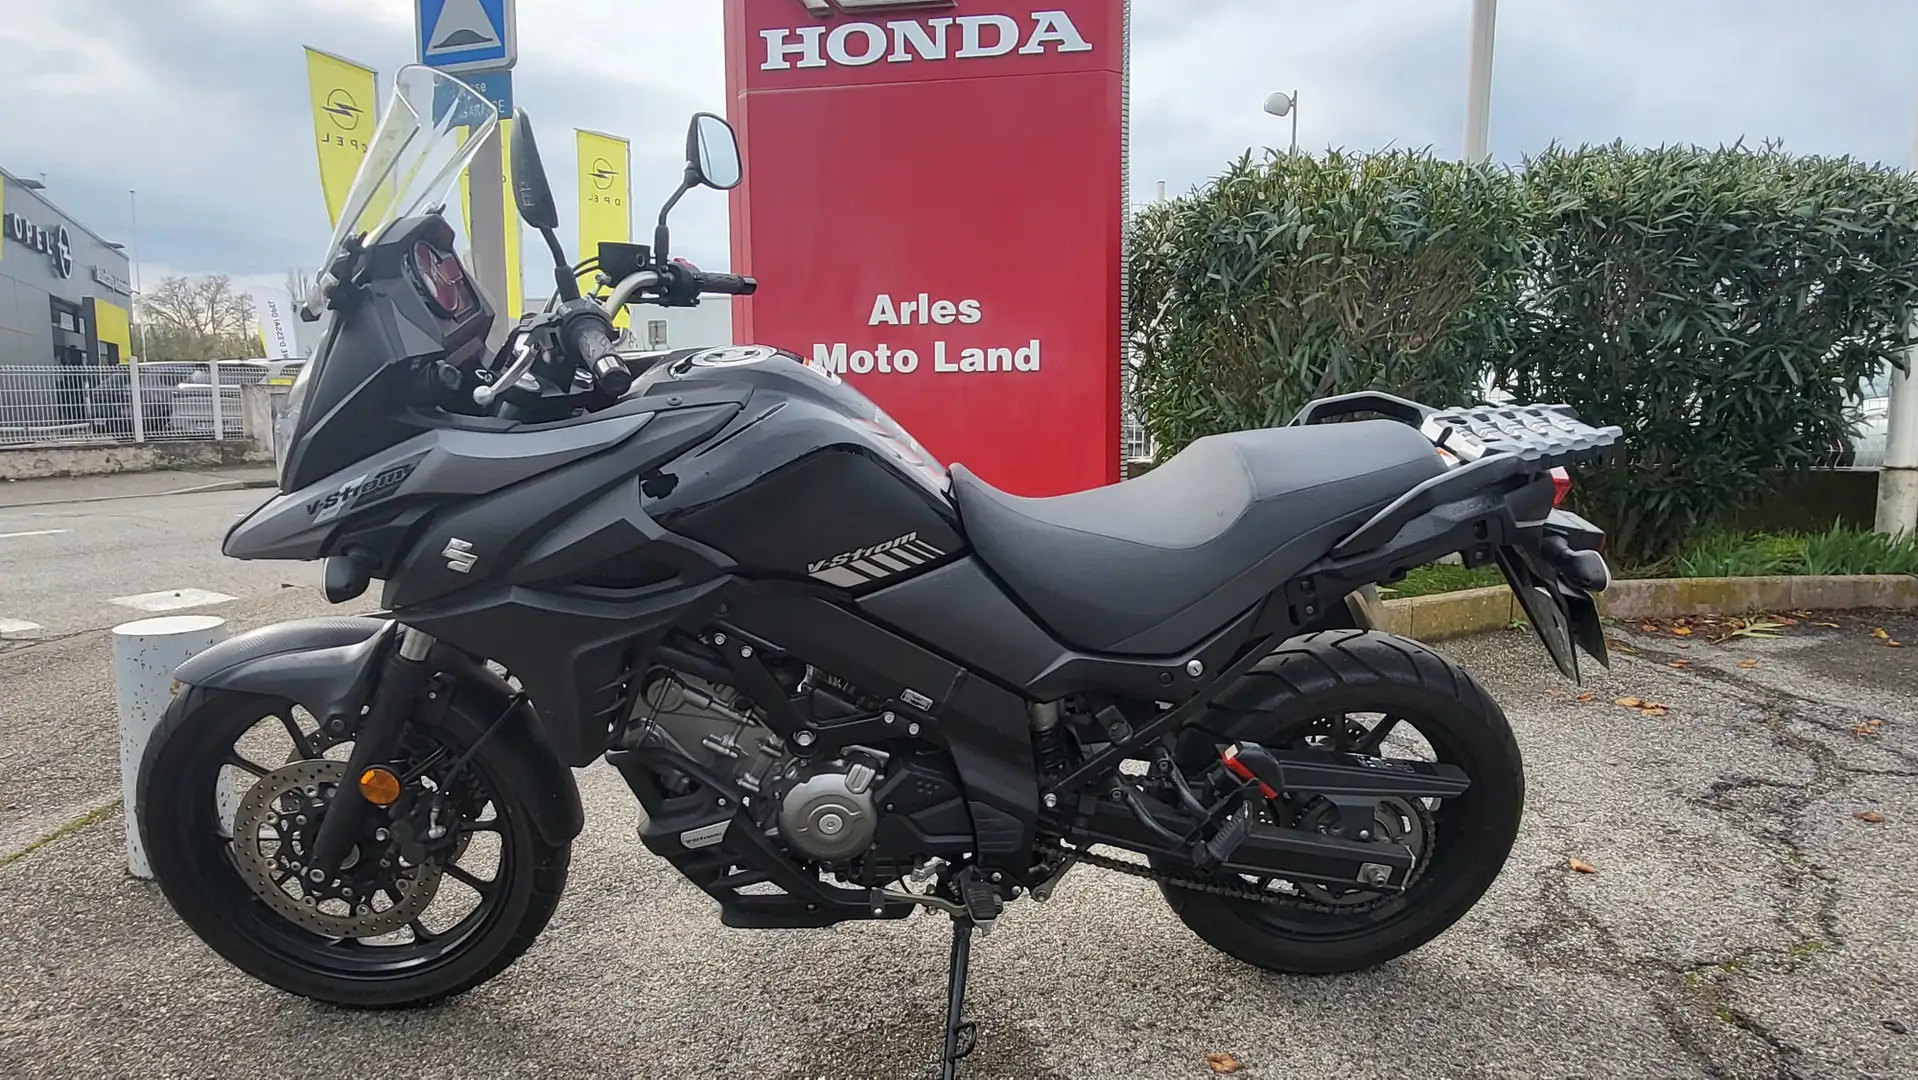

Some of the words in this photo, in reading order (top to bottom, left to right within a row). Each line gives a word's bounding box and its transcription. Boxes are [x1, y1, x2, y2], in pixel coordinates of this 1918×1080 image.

[759, 10, 1093, 71] HONDA
[13, 212, 53, 255] OPEL
[868, 293, 982, 325] Arles
[813, 342, 919, 374] Moto
[934, 340, 1040, 372] Land
[306, 468, 405, 515] V-Strom
[807, 531, 917, 572] V-Strom
